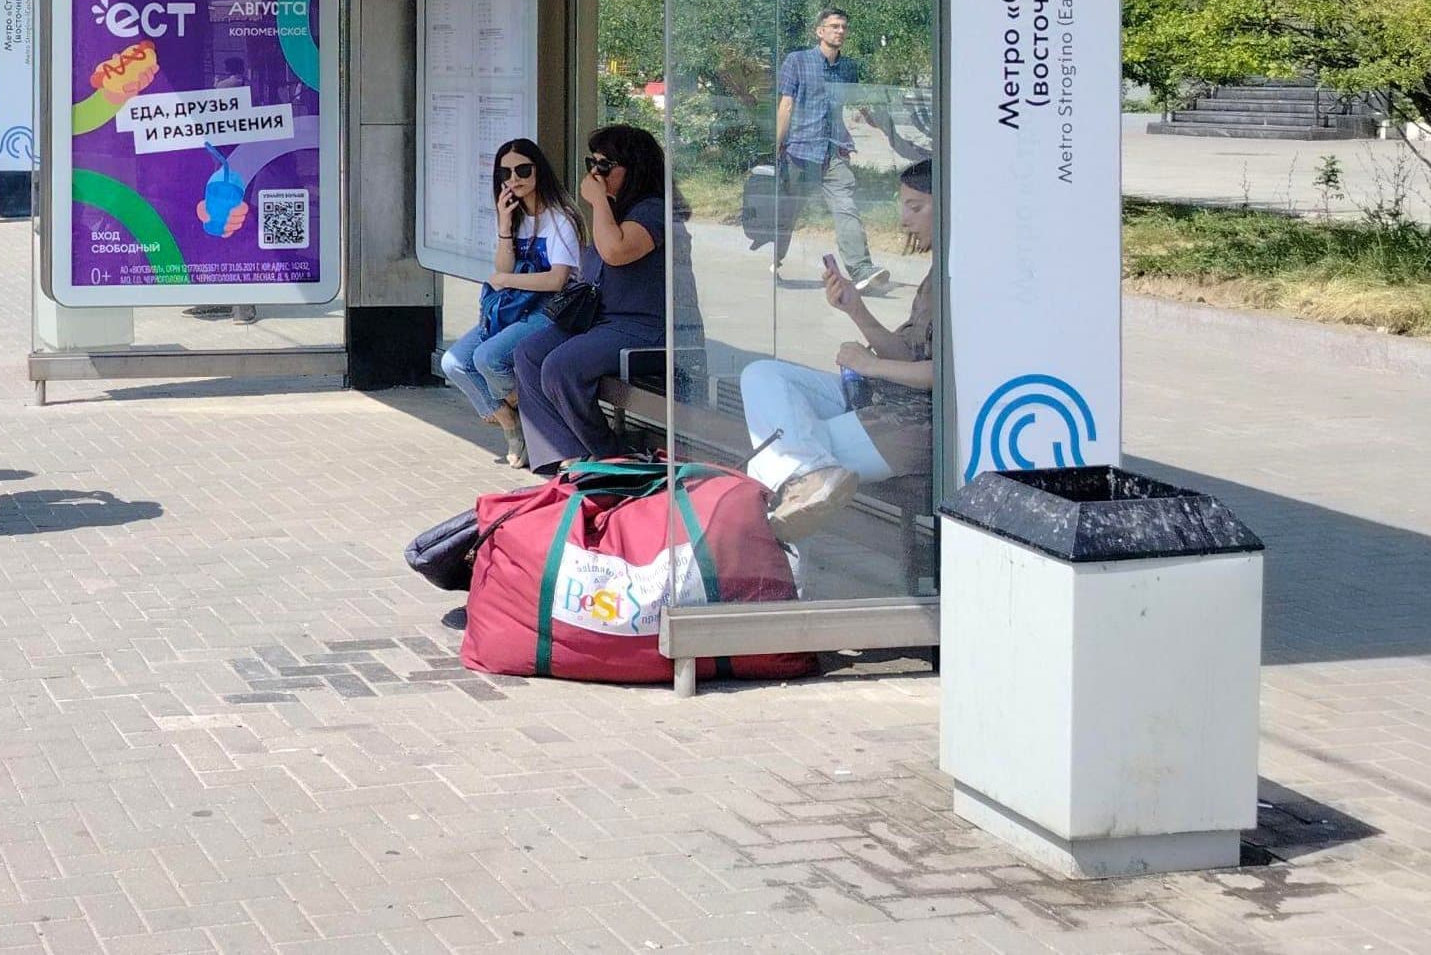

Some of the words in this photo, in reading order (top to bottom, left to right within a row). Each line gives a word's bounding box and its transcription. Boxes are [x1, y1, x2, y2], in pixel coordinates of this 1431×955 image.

[229, 27, 308, 37] КОЛОМЕНСКОЕ
[998, 29, 1024, 130] Метро
[1058, 32, 1076, 116] Strogino
[130, 106, 170, 120] ЕДА,
[174, 97, 239, 116] ДРУЗЬЯ
[145, 128, 158, 141] И
[164, 115, 284, 140] РАЗВЛЕЧЕНИЯ
[1058, 123, 1073, 183] Metro
[91, 231, 120, 242] ВХОД
[91, 242, 161, 254] СВОБОДНЫЙ
[91, 267, 112, 285] 0+
